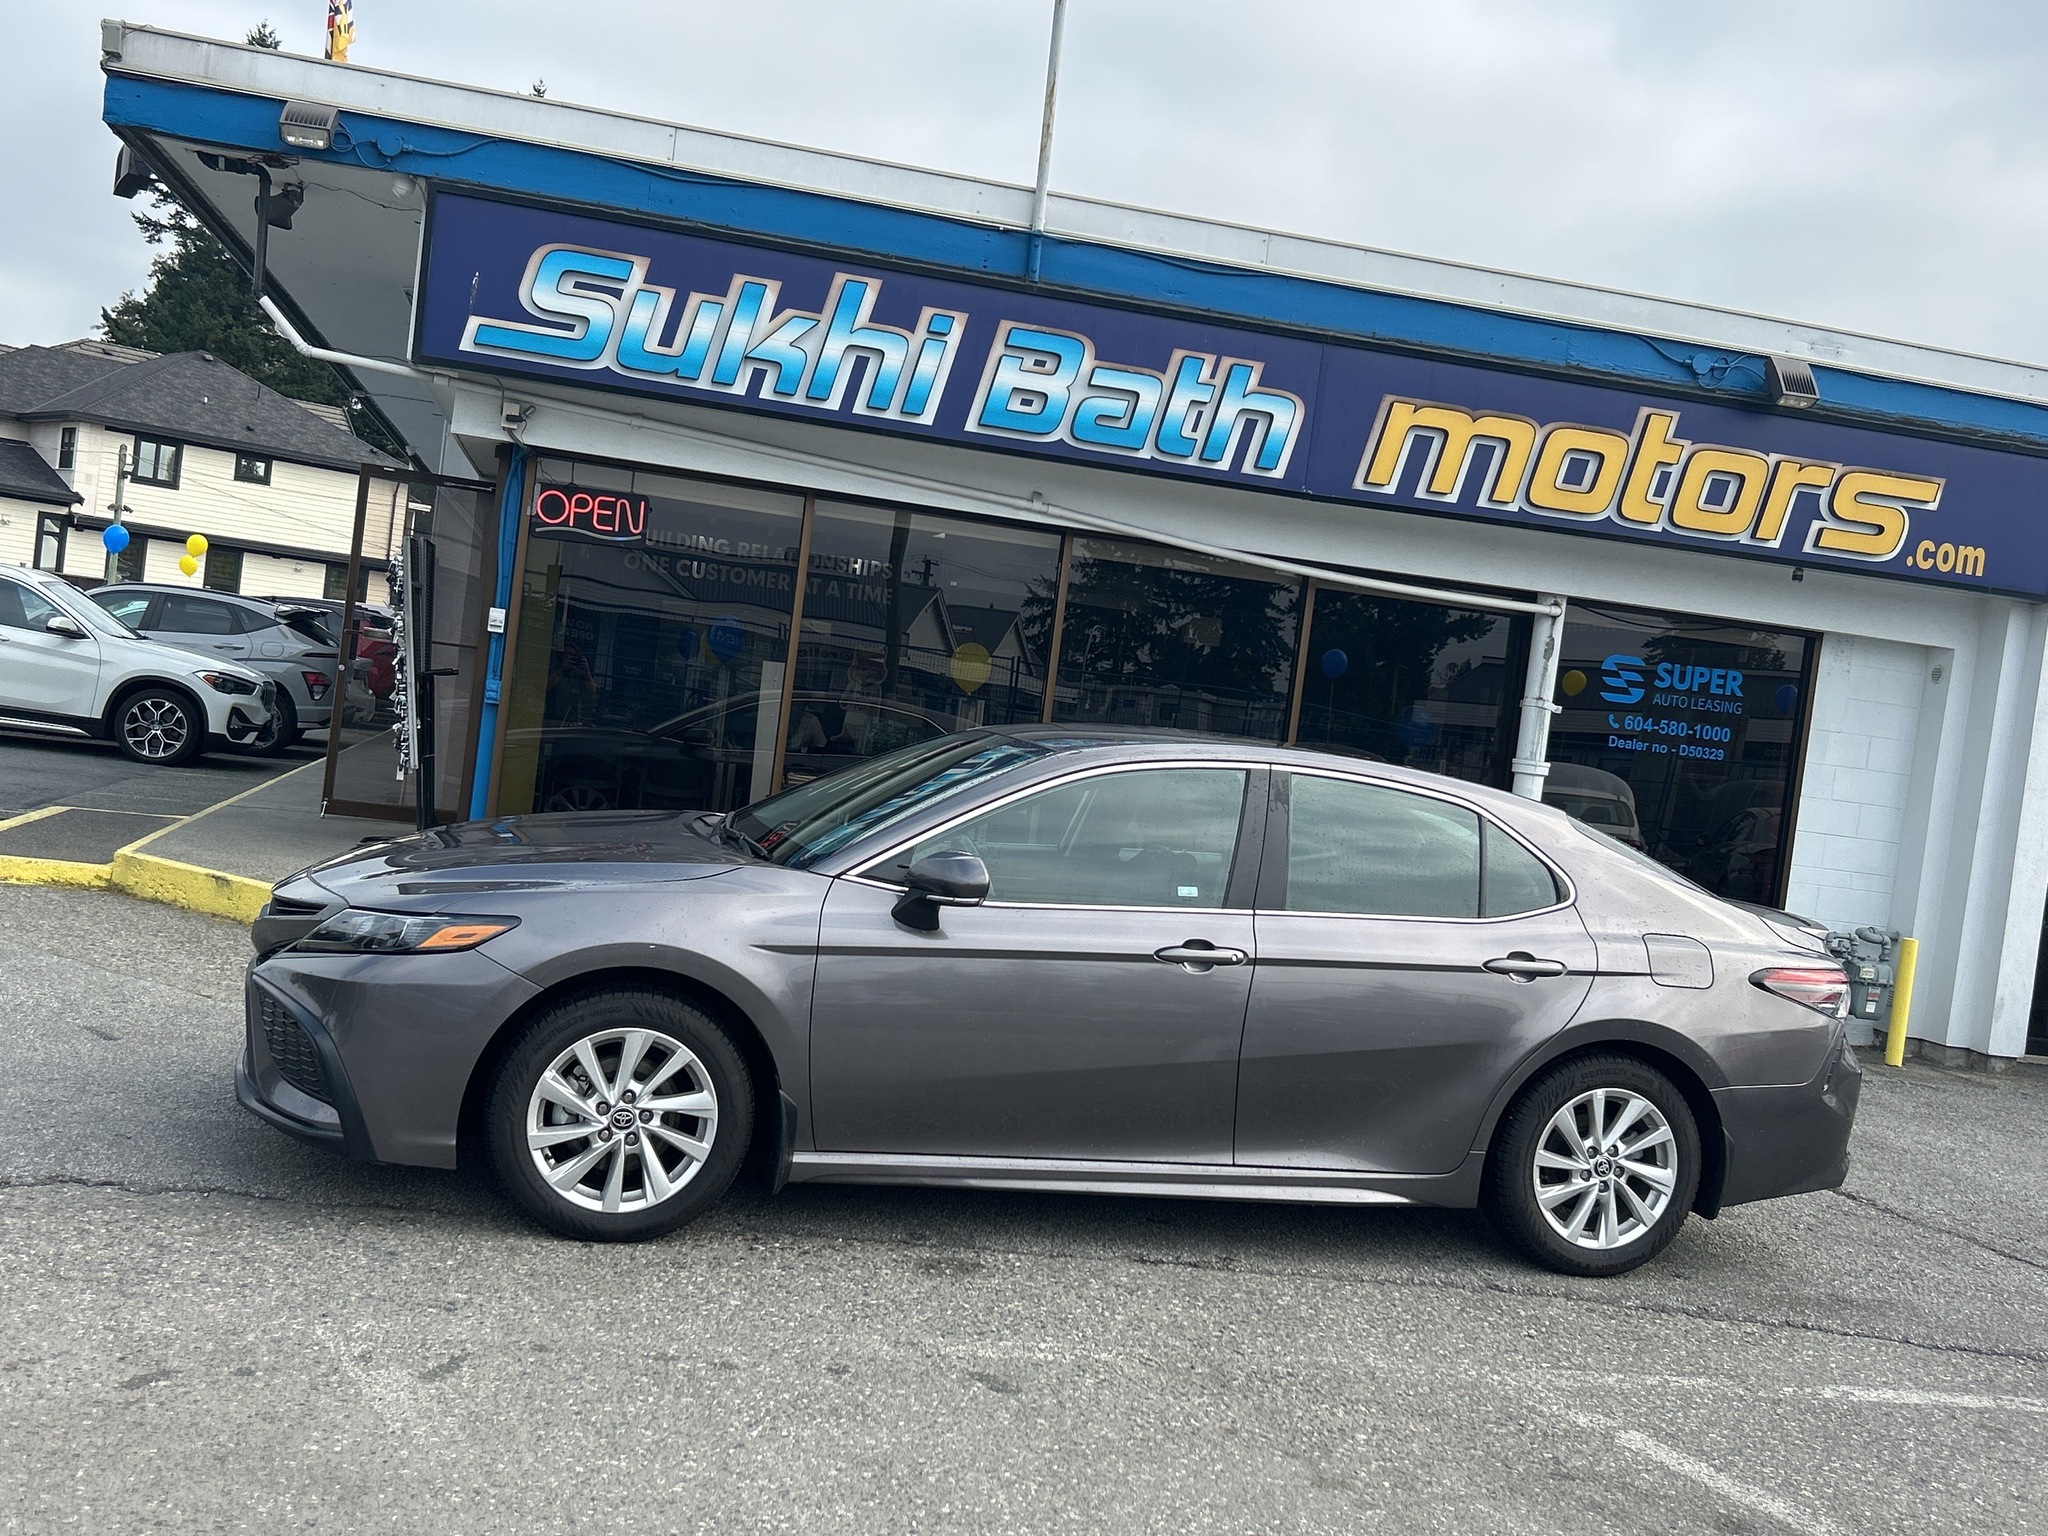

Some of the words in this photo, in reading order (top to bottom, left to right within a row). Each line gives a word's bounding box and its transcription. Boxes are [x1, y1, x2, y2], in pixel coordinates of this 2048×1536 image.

[460, 245, 967, 425] Sukhi
[966, 322, 1304, 478] Bath
[1352, 395, 1945, 562] motors
[1906, 539, 1985, 578] .com
[537, 490, 646, 534] OPEN
[646, 528, 731, 555] UILDING
[676, 559, 791, 591] CUSTOMER
[825, 581, 840, 598] A
[847, 582, 893, 605] TIME
[1653, 661, 1744, 697] SUPER
[1652, 693, 1688, 708] AUTO
[1691, 697, 1743, 715] LEASING
[1624, 715, 1731, 743] 604-580-1000
[1608, 735, 1649, 751] Dealer
[1652, 742, 1668, 754] no
[1679, 744, 1724, 761] D50329
